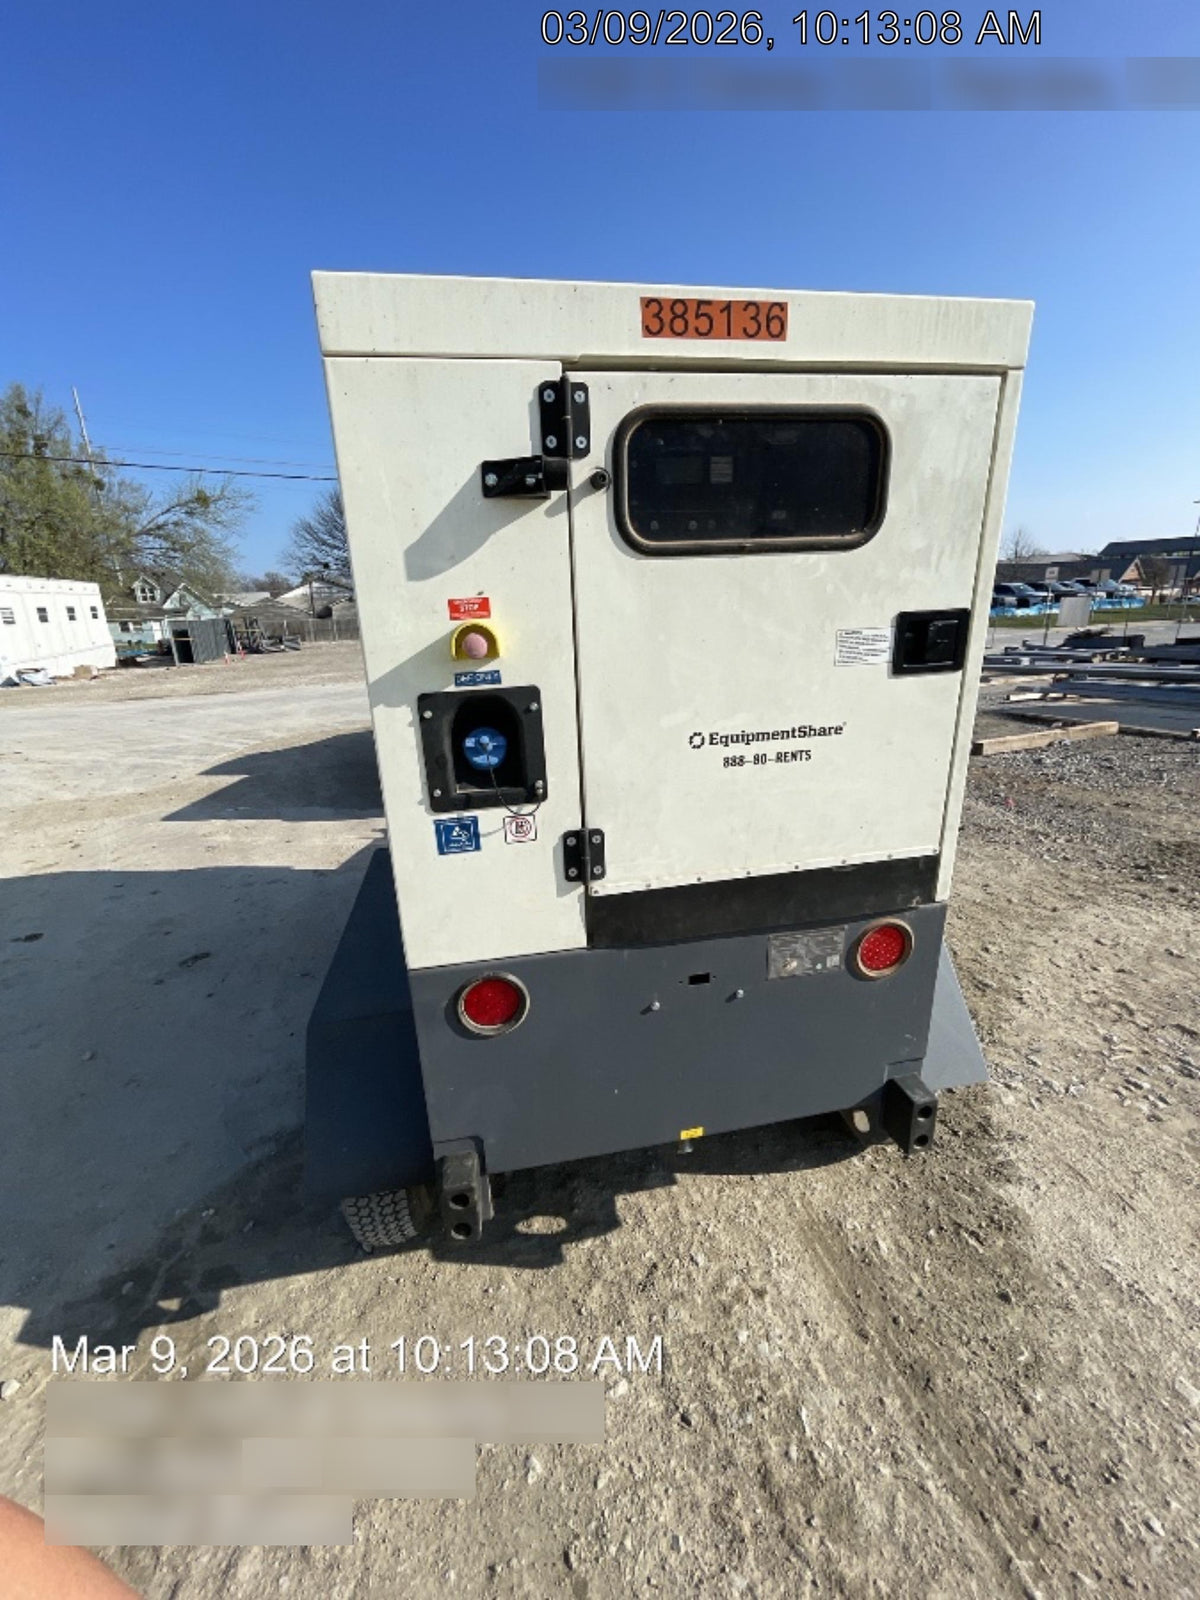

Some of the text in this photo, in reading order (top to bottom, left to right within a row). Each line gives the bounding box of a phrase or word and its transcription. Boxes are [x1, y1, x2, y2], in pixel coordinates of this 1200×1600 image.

[645, 299, 785, 338] 385136
[708, 724, 844, 747] EquipmentShare
[723, 750, 812, 768] 888-80-RENTS
